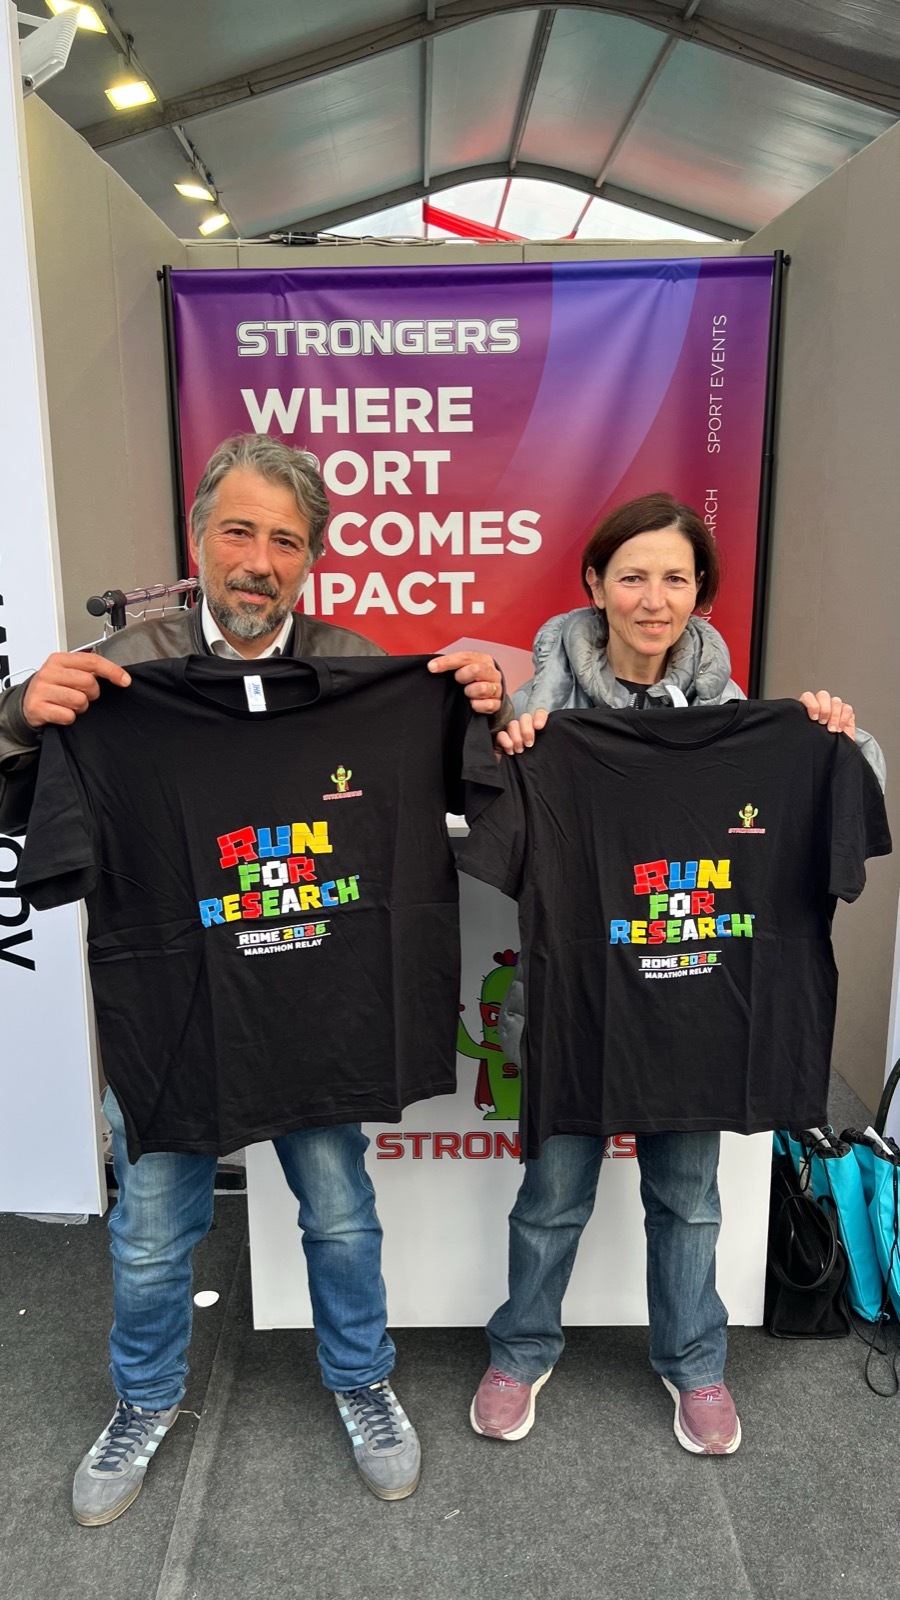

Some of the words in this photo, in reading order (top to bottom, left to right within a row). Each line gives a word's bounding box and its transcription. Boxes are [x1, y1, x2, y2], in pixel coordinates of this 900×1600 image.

[237, 318, 520, 357] STRONGERS
[710, 315, 727, 388] EVENTS
[240, 386, 474, 434] WHERE
[707, 393, 723, 454] SPORT
[304, 449, 451, 496] ORT
[322, 509, 543, 557] COMES
[217, 821, 333, 869] RUN
[238, 856, 318, 891] FOR
[633, 859, 732, 895] RUN
[199, 874, 360, 928] RESEARCH
[649, 890, 715, 920] FOR
[238, 930, 281, 945] ROME
[282, 923, 326, 940] 2026
[243, 942, 294, 956] MARATHON
[294, 938, 323, 949] RELAY
[609, 914, 756, 945] RESEARCH
[641, 957, 678, 969] ROME
[679, 953, 717, 966] 2026
[644, 969, 689, 979] MARATHON
[688, 966, 713, 976] RELAY
